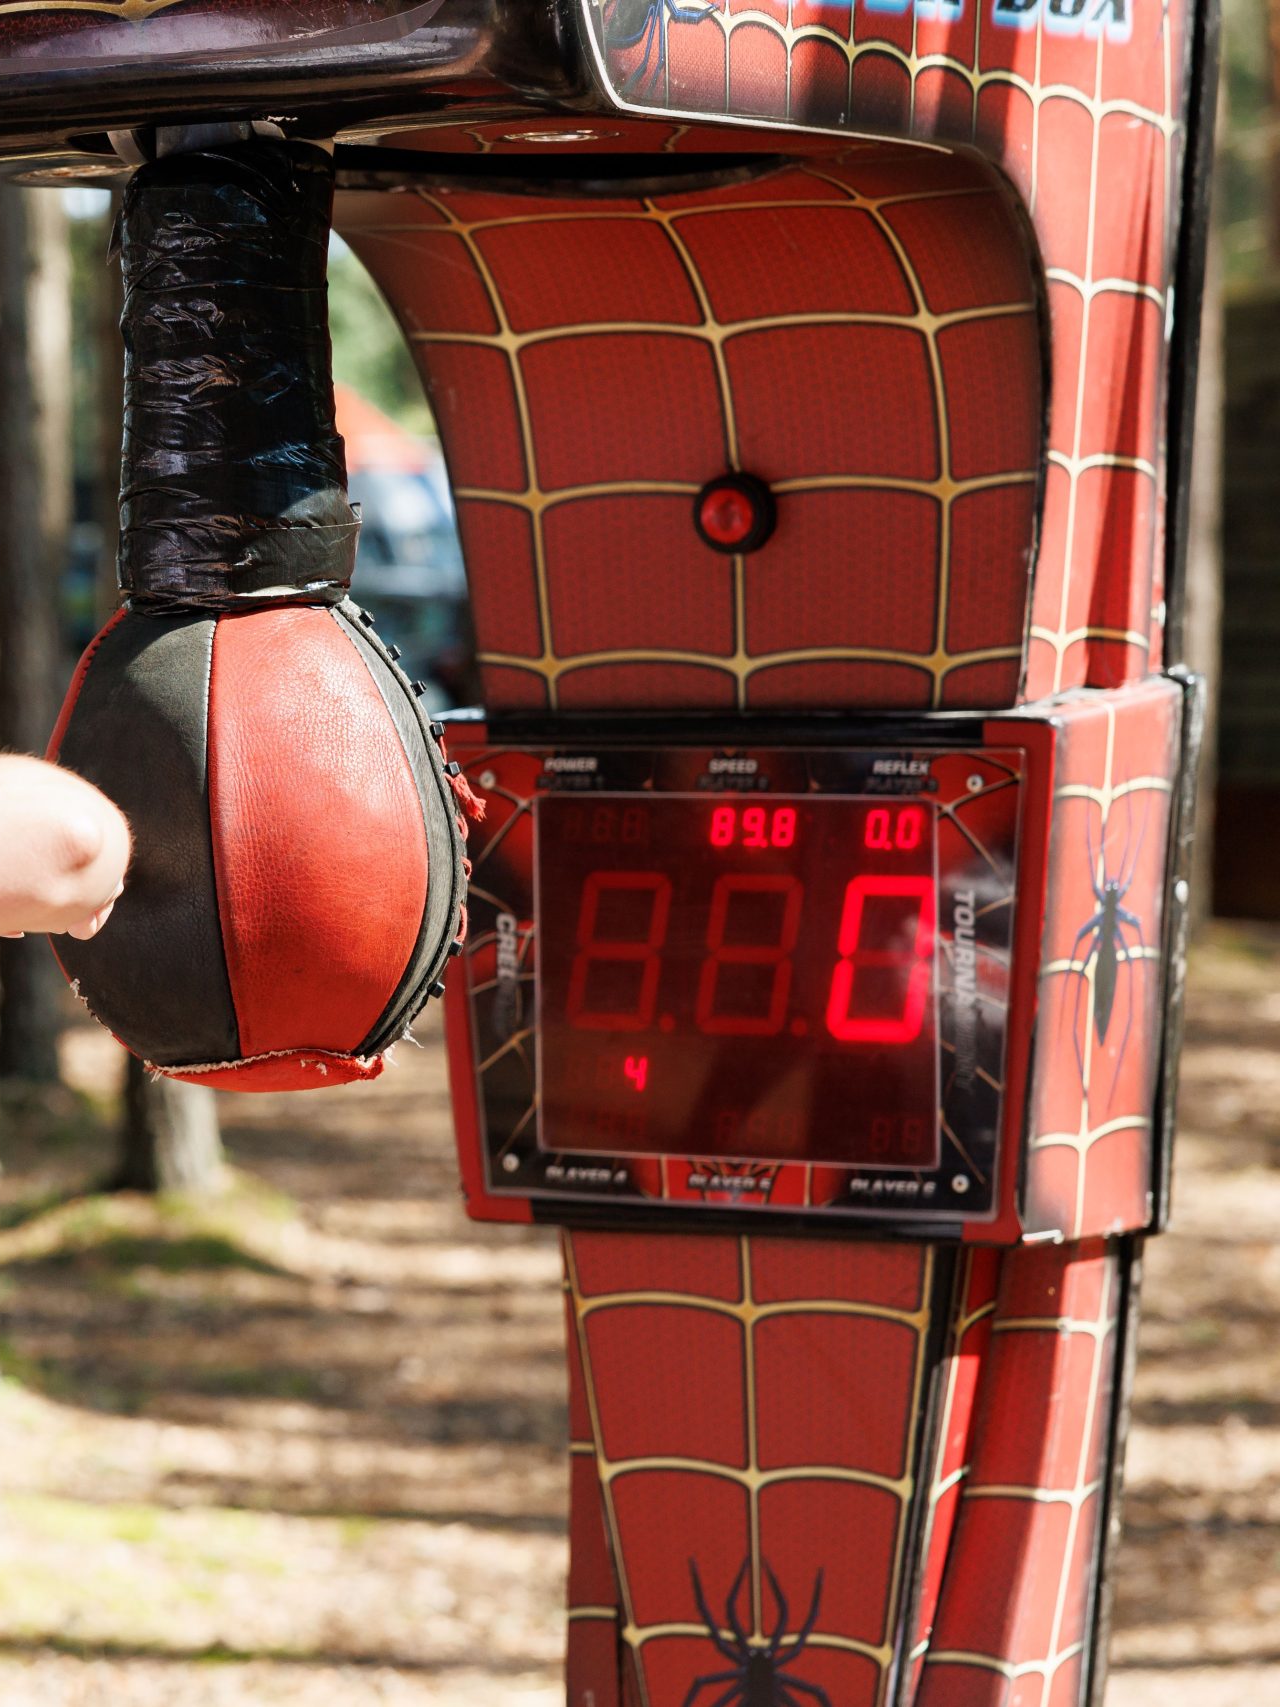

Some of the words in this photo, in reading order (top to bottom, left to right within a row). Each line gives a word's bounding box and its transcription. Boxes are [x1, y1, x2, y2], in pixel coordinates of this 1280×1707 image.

[544, 757, 598, 773] POWER
[708, 758, 759, 774] SPEED
[872, 759, 930, 776] REFLEX
[864, 808, 922, 850] 0.0
[623, 1056, 649, 1091] 4
[545, 1165, 612, 1182] PLAYER
[688, 1173, 756, 1190] PLAYER
[850, 1178, 921, 1194] PLAYER
